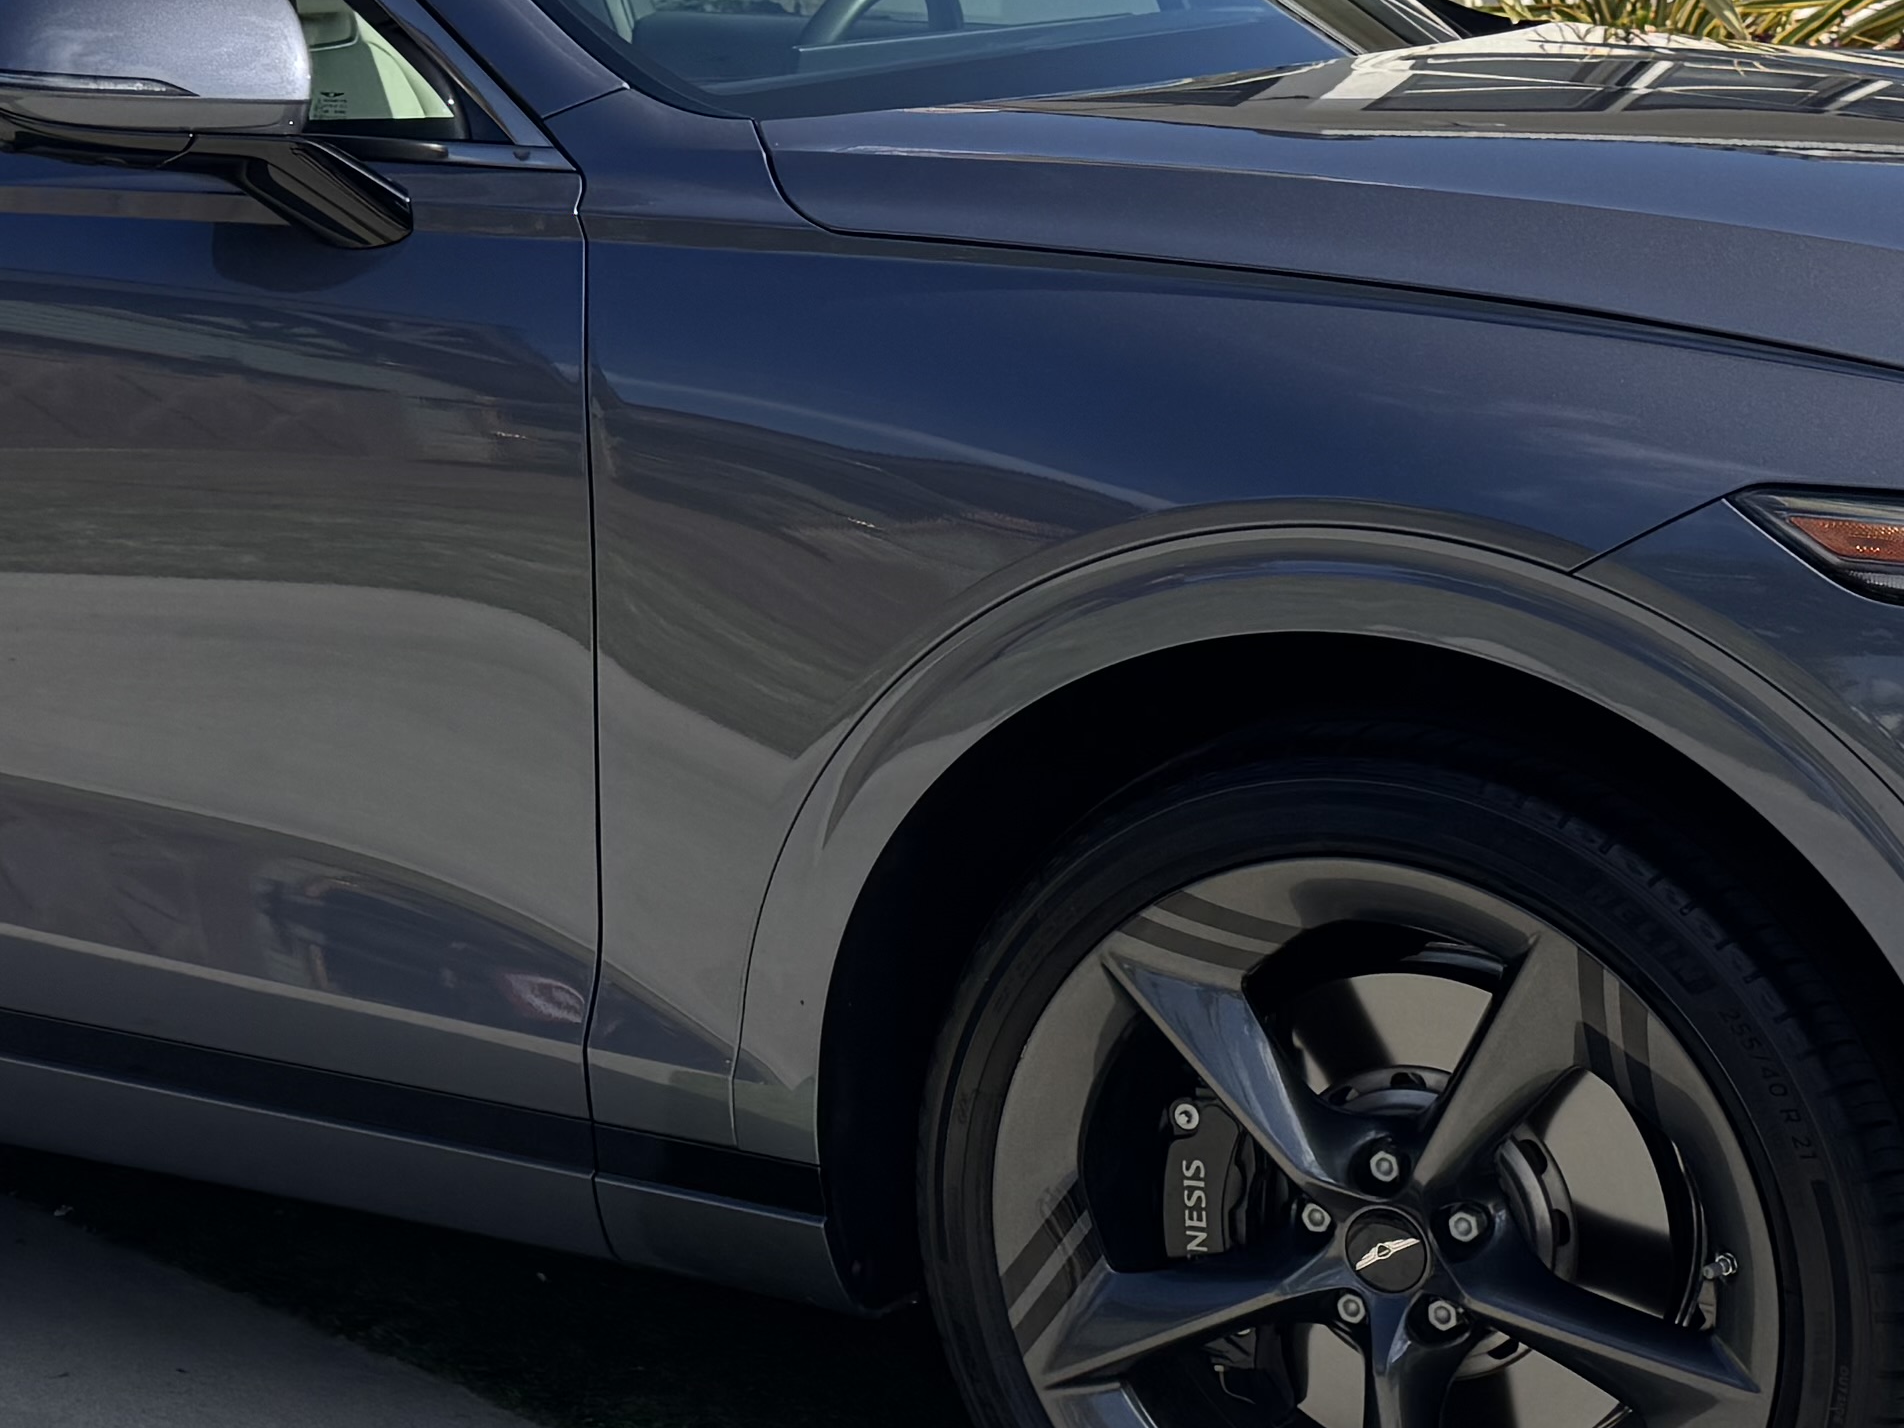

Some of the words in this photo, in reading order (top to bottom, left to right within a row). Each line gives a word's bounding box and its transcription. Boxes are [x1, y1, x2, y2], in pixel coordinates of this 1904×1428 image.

[1717, 1010, 1789, 1098] 255/40
[1779, 1108, 1801, 1123] R
[1791, 1135, 1818, 1160] 21
[1182, 1159, 1209, 1258] NESIS
